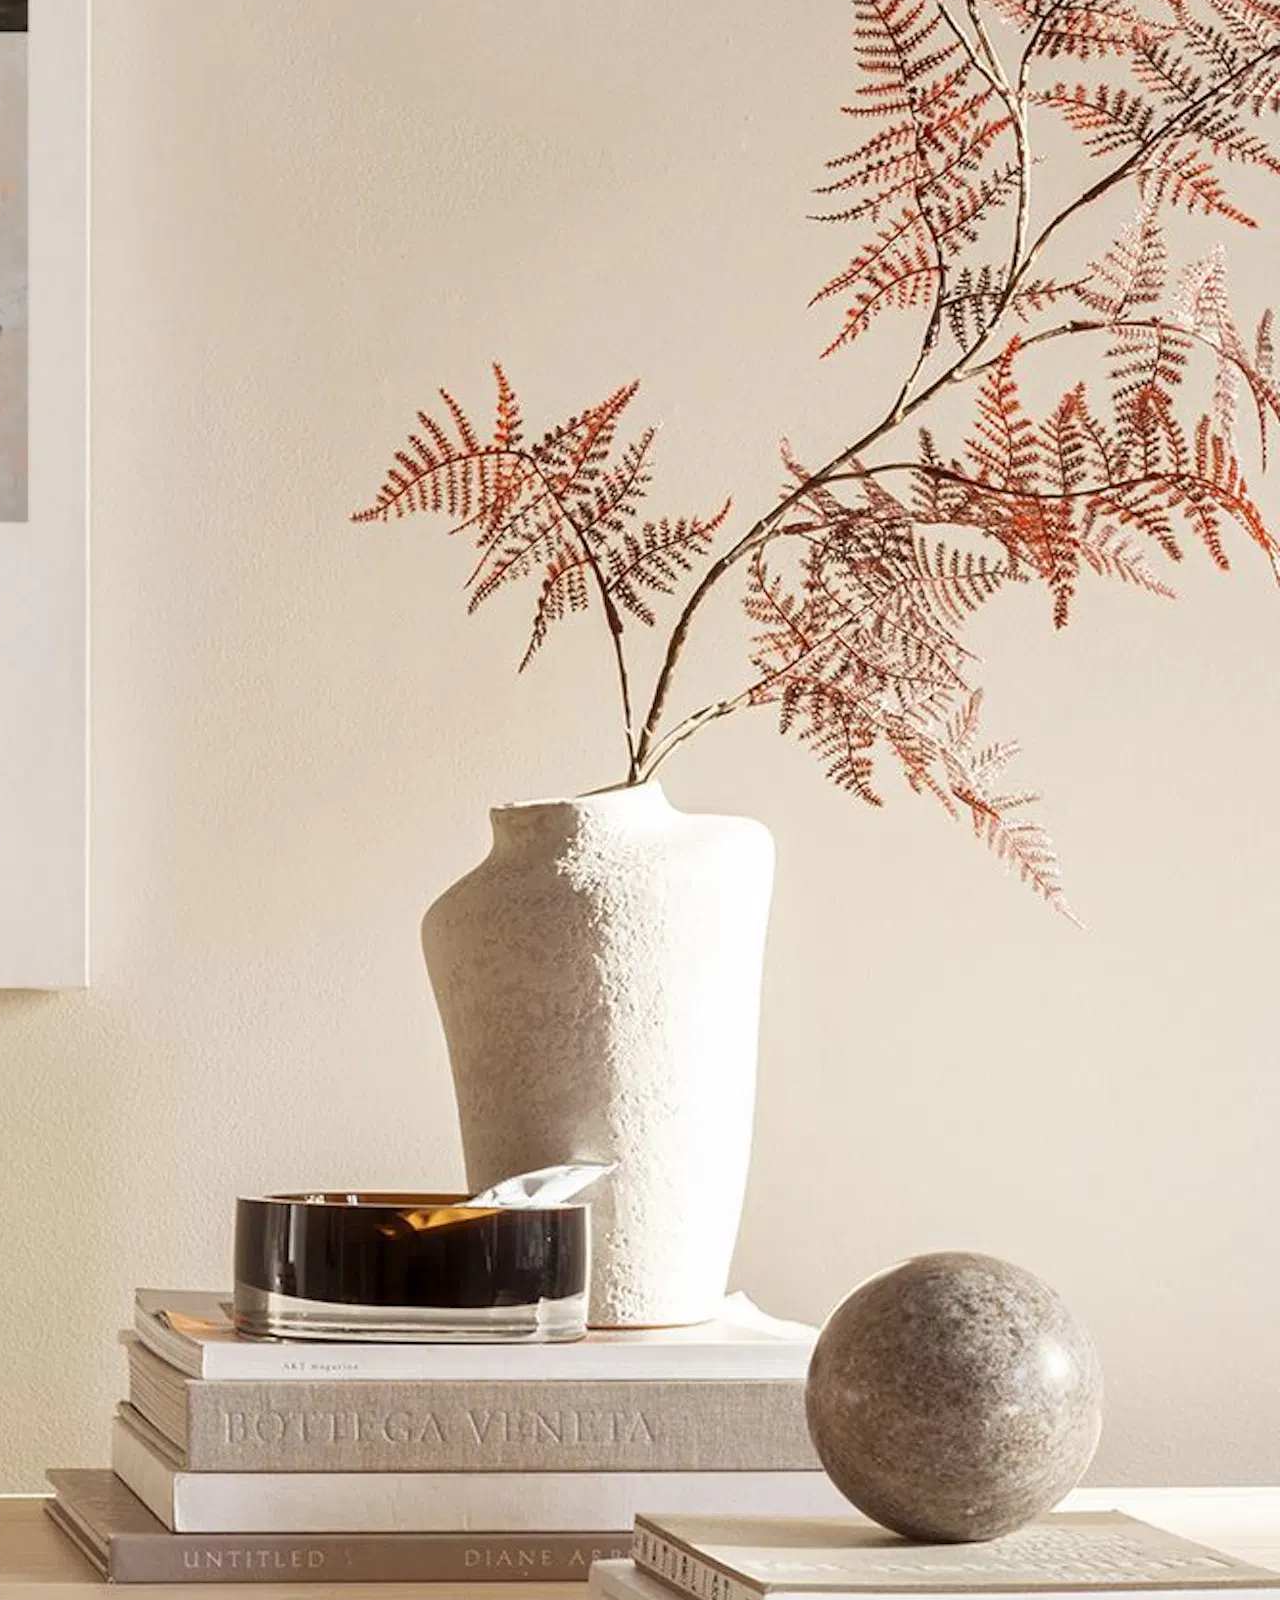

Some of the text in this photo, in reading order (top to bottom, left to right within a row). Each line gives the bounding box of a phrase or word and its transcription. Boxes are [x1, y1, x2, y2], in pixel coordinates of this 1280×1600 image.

[223, 1410, 657, 1446] BOTTEGA VENETA
[184, 1550, 326, 1569] UNTITLED
[464, 1548, 553, 1567] DIANE
